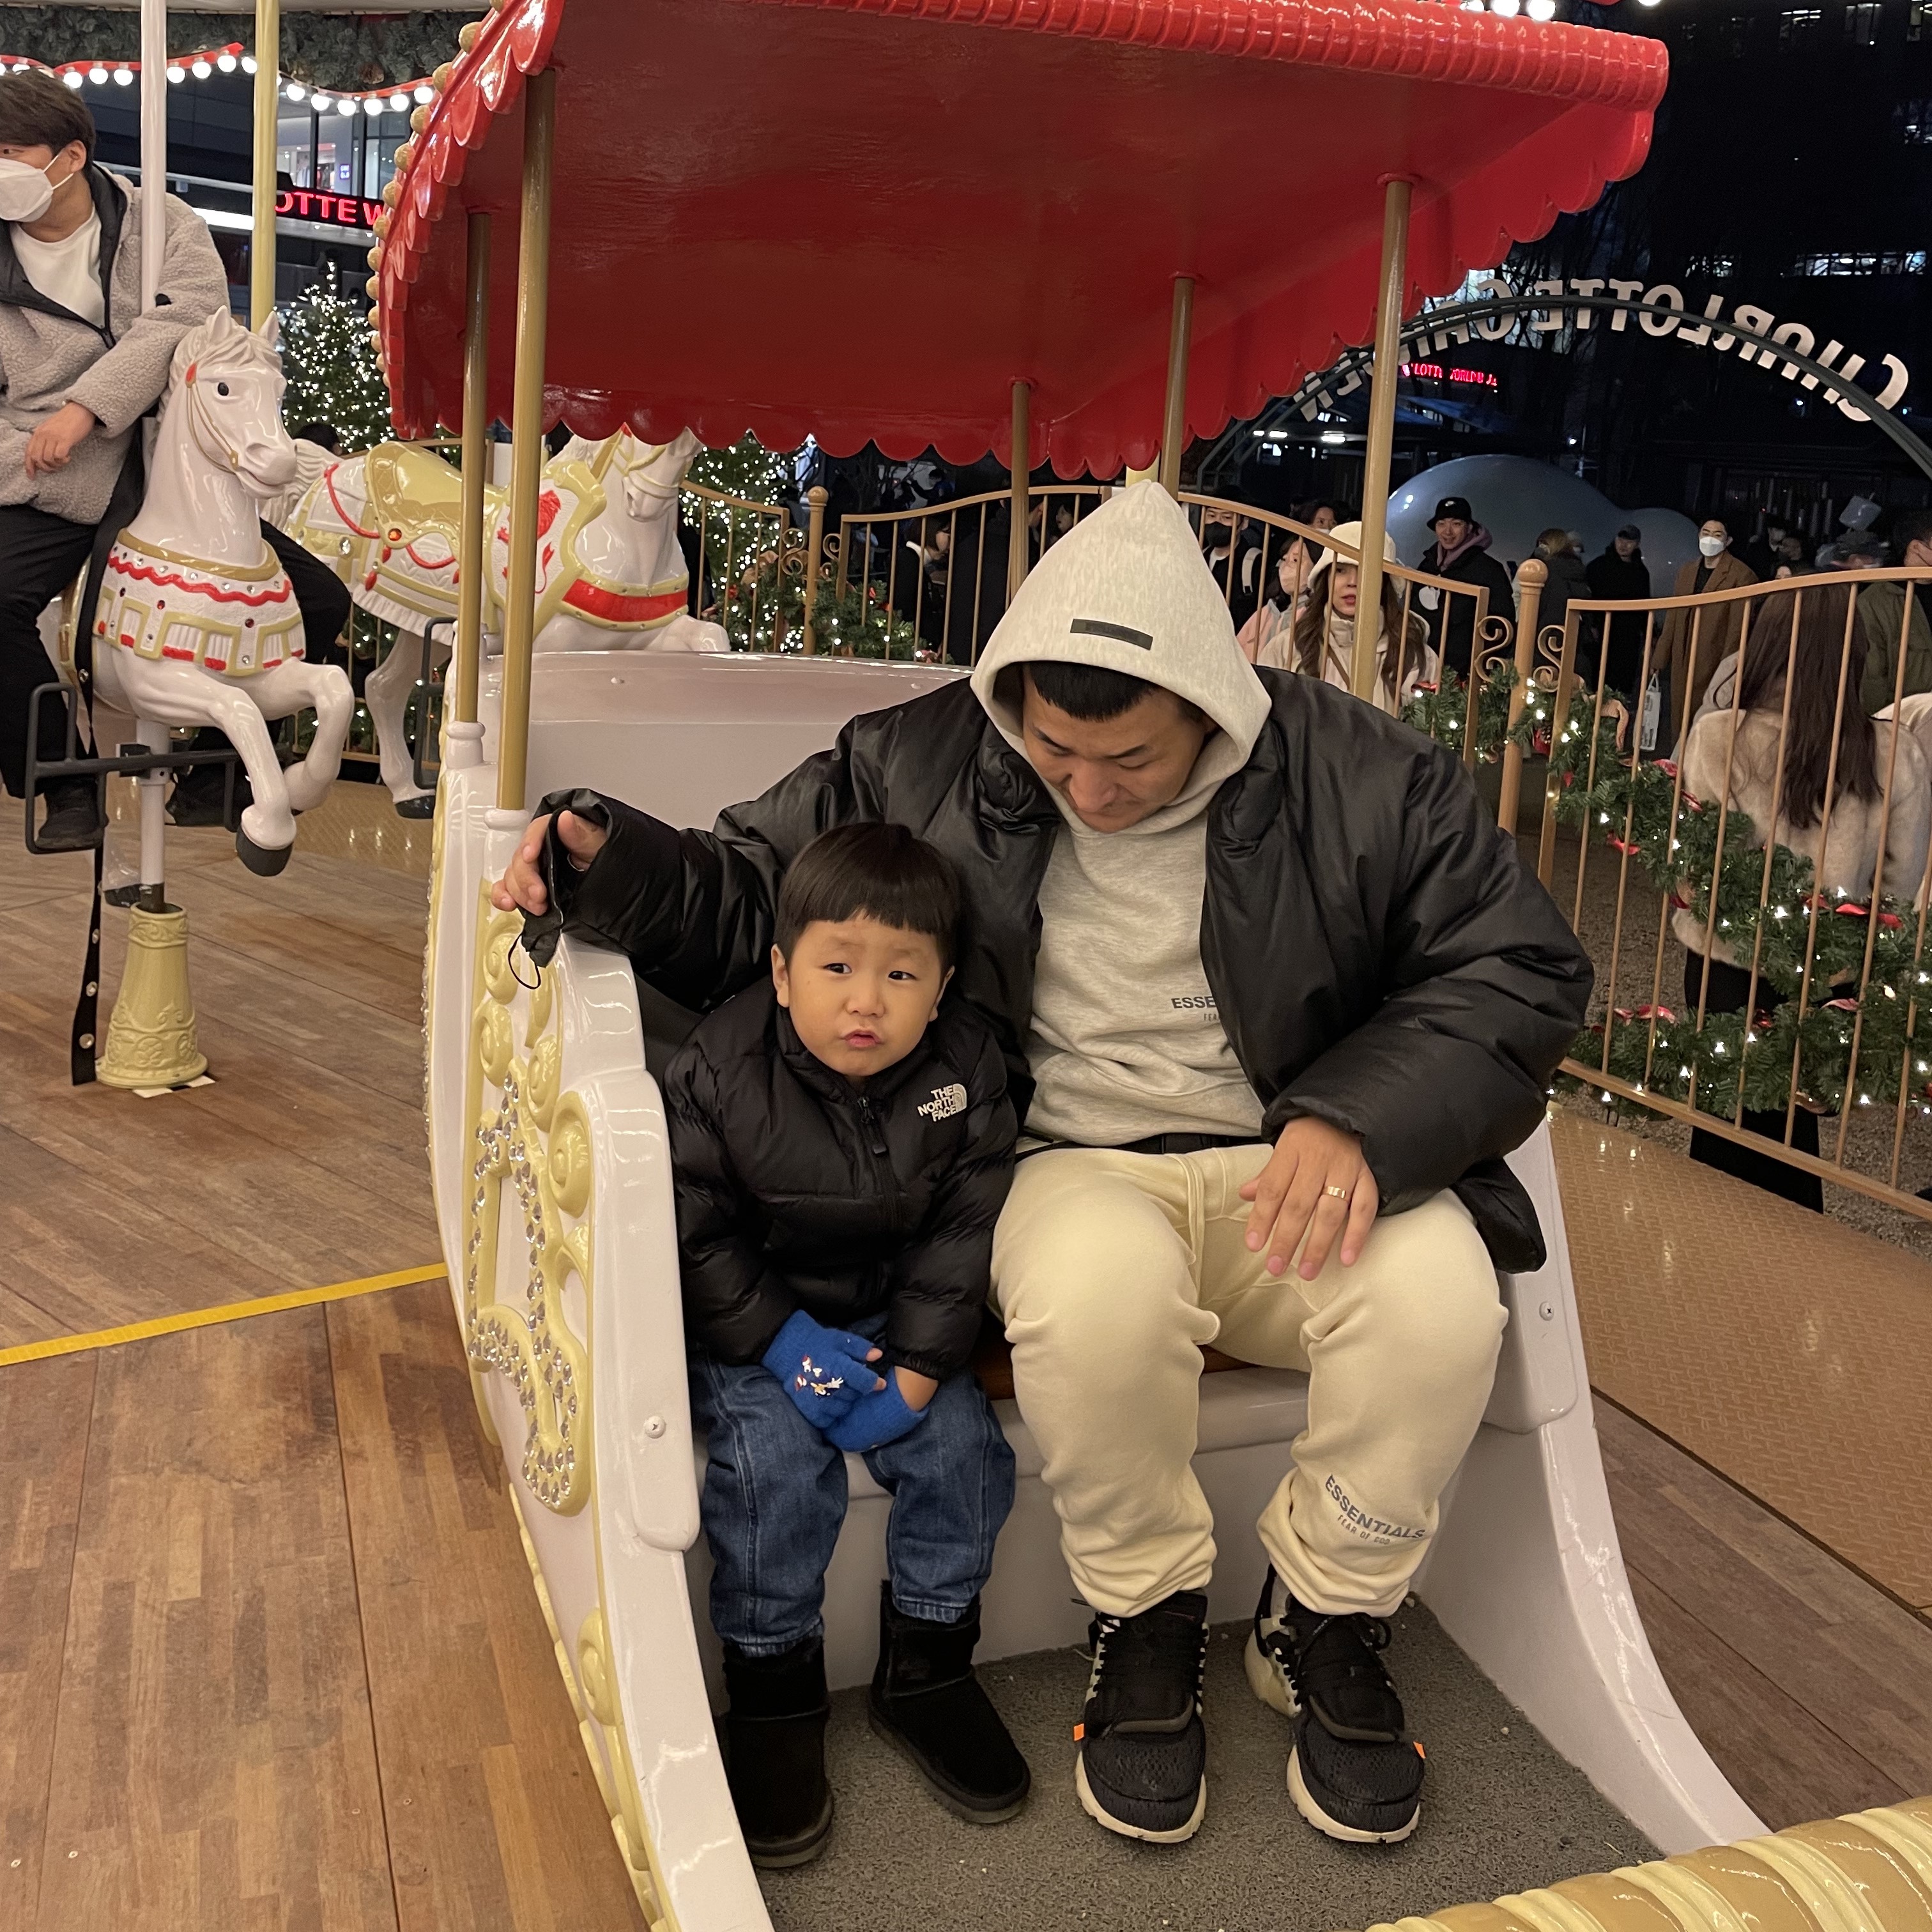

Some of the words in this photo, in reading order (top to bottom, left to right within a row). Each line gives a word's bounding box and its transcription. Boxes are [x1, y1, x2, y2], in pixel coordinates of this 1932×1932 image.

[1171, 996, 1216, 1009] ESSE
[930, 1085, 954, 1100] THE
[917, 1095, 955, 1117] NORTH
[931, 1104, 957, 1122] FACE
[1325, 1474, 1425, 1538] ESSENTIALS
[1337, 1514, 1358, 1534] FEAR
[1360, 1531, 1370, 1540] OF
